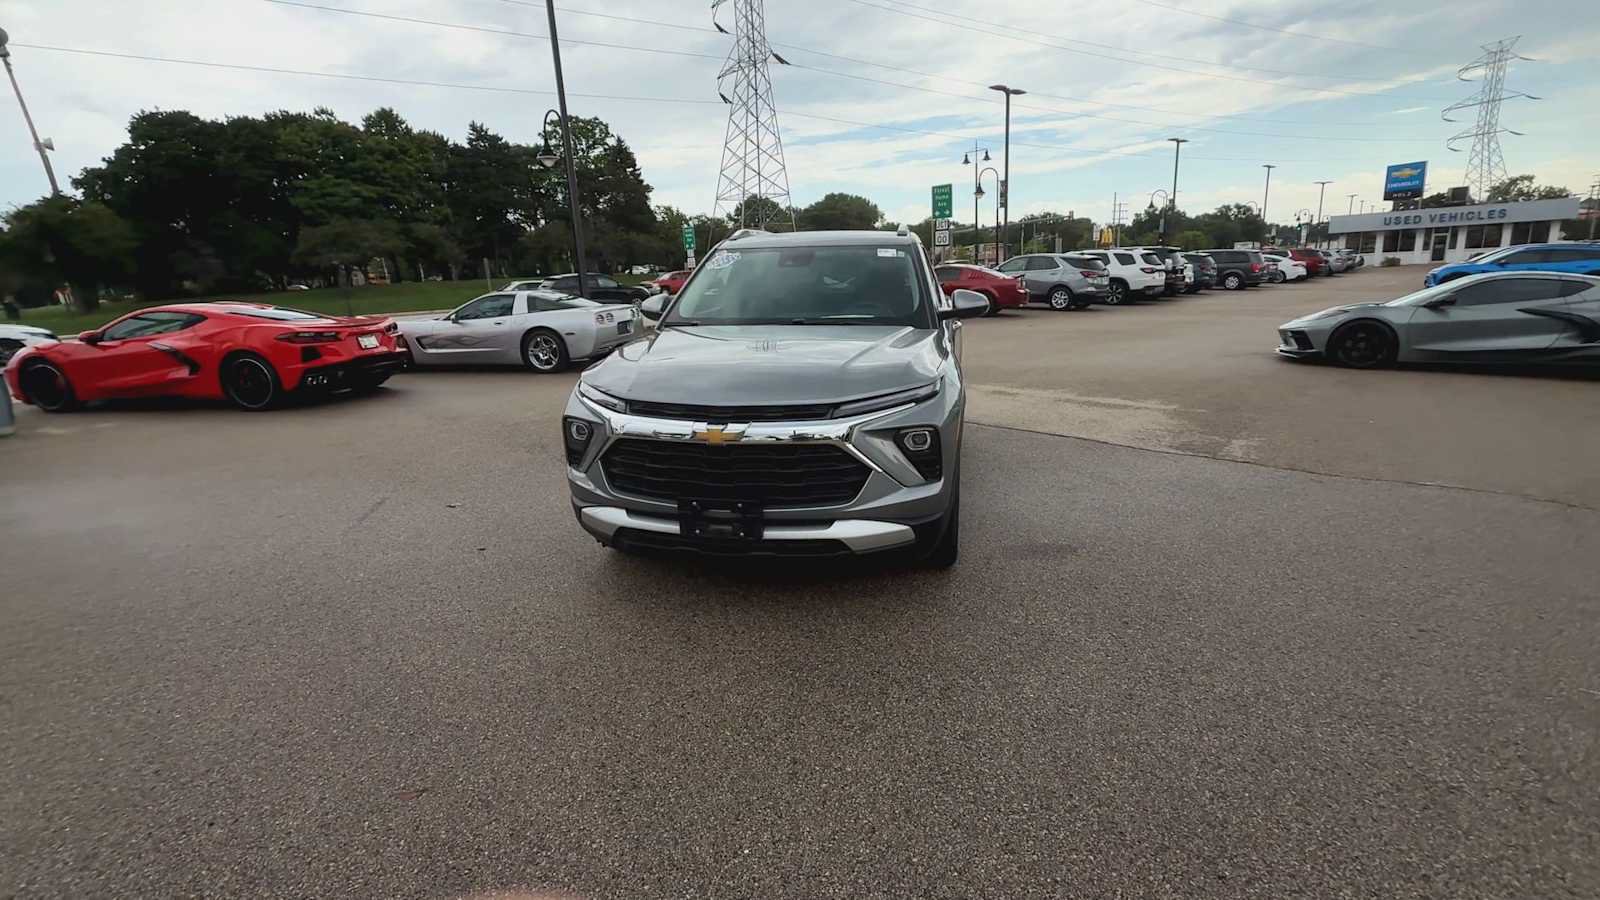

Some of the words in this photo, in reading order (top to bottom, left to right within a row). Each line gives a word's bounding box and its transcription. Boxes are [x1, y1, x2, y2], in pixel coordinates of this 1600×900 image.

[1387, 180, 1420, 189] CHEVROLET
[1383, 215, 1422, 226] USED
[1429, 208, 1507, 223] VEHICLES
